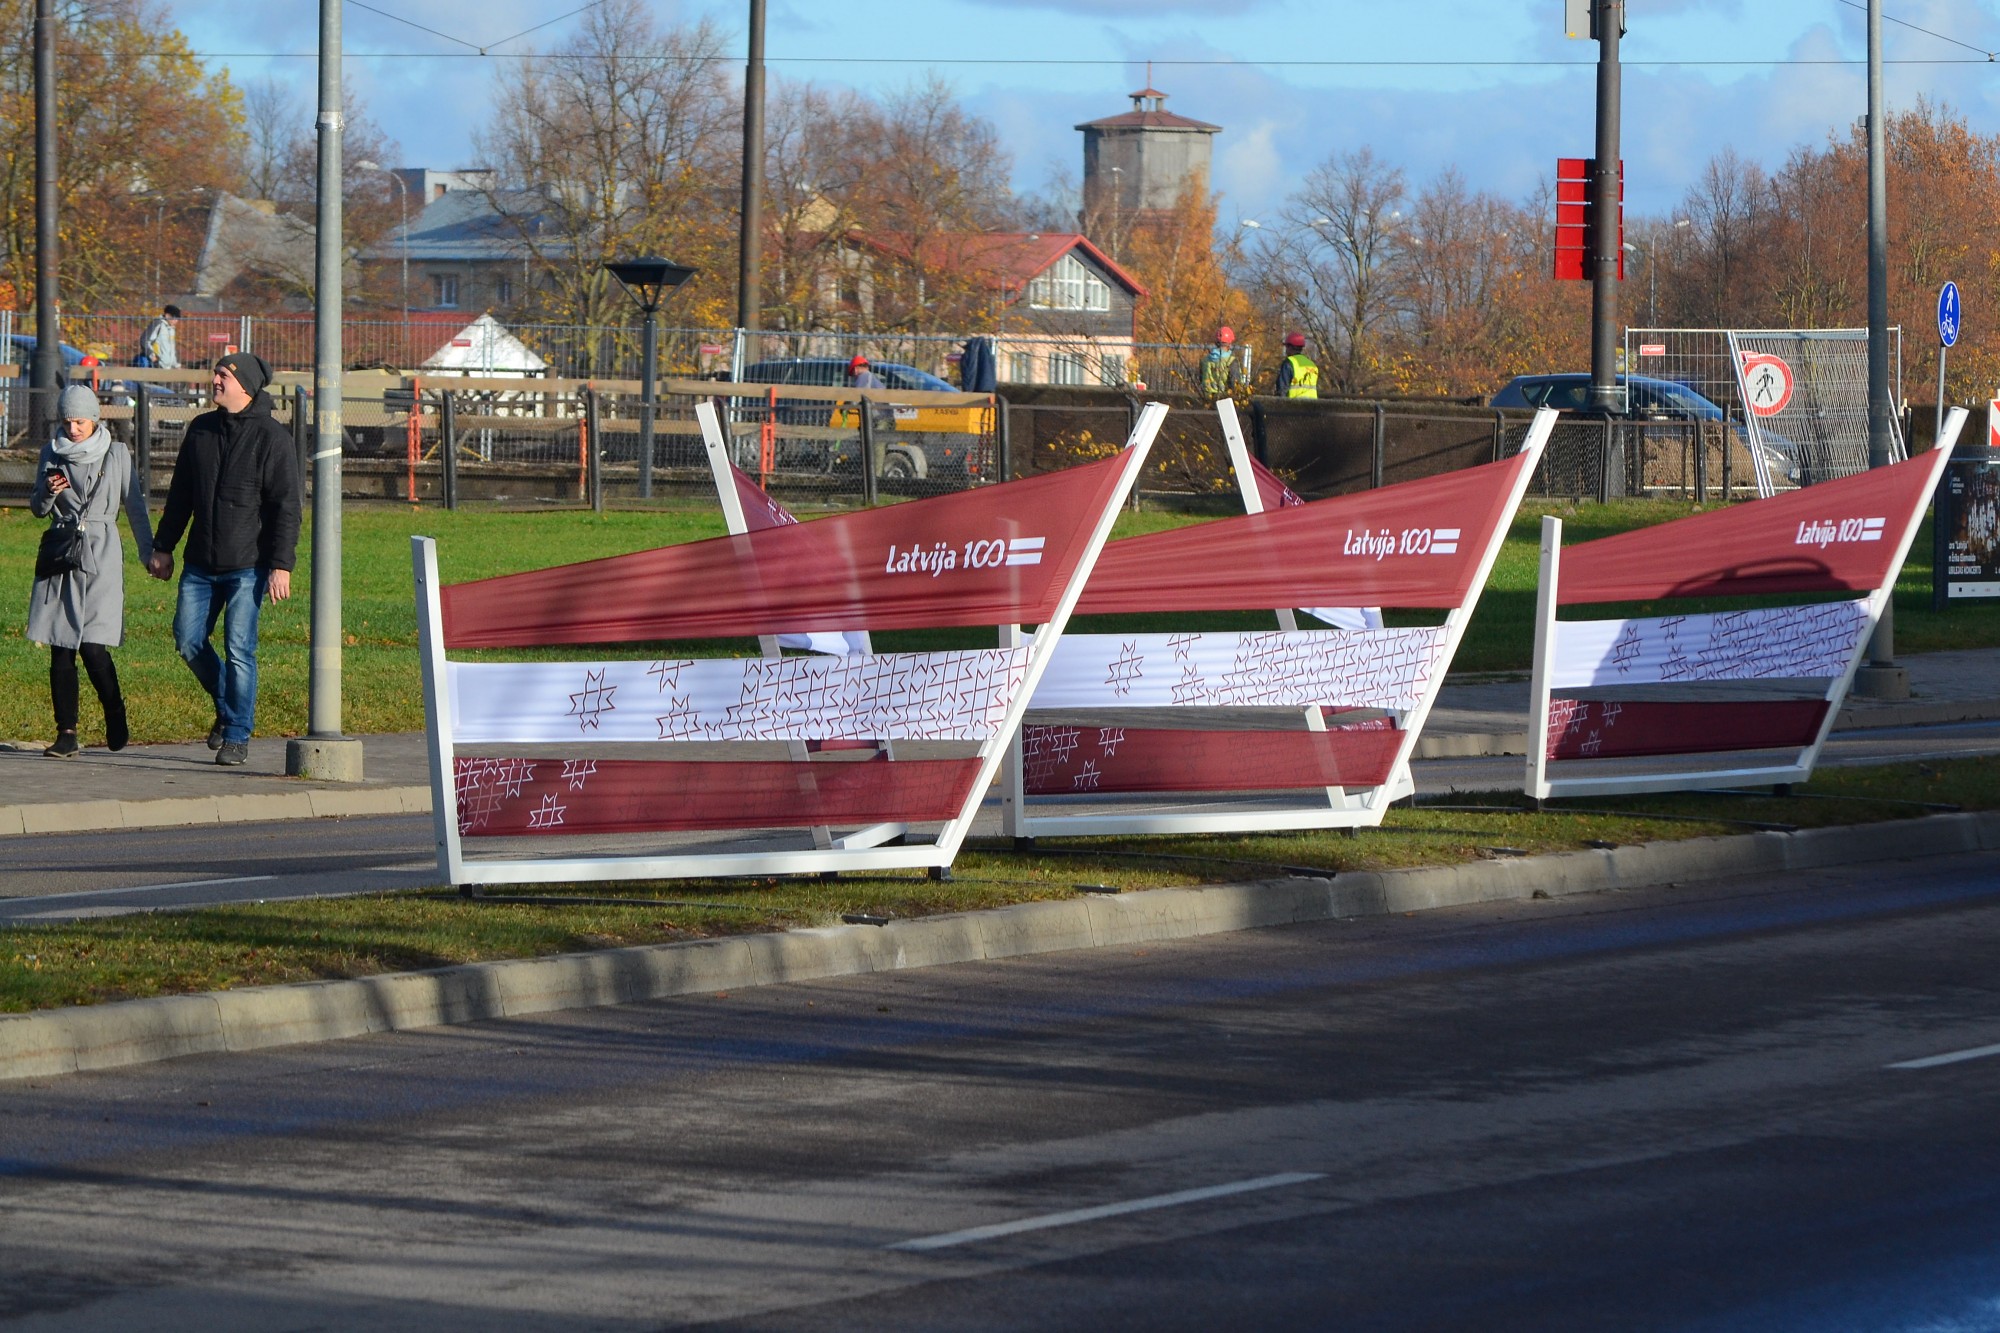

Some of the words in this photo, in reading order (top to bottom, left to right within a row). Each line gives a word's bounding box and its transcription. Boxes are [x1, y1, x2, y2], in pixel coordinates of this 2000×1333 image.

[1343, 528, 1396, 561] Latvija
[1399, 528, 1432, 555] 100
[1795, 519, 1837, 549] Latvija
[1837, 517, 1864, 542] 100
[886, 542, 957, 578] Latvija
[963, 538, 1006, 569] 100
